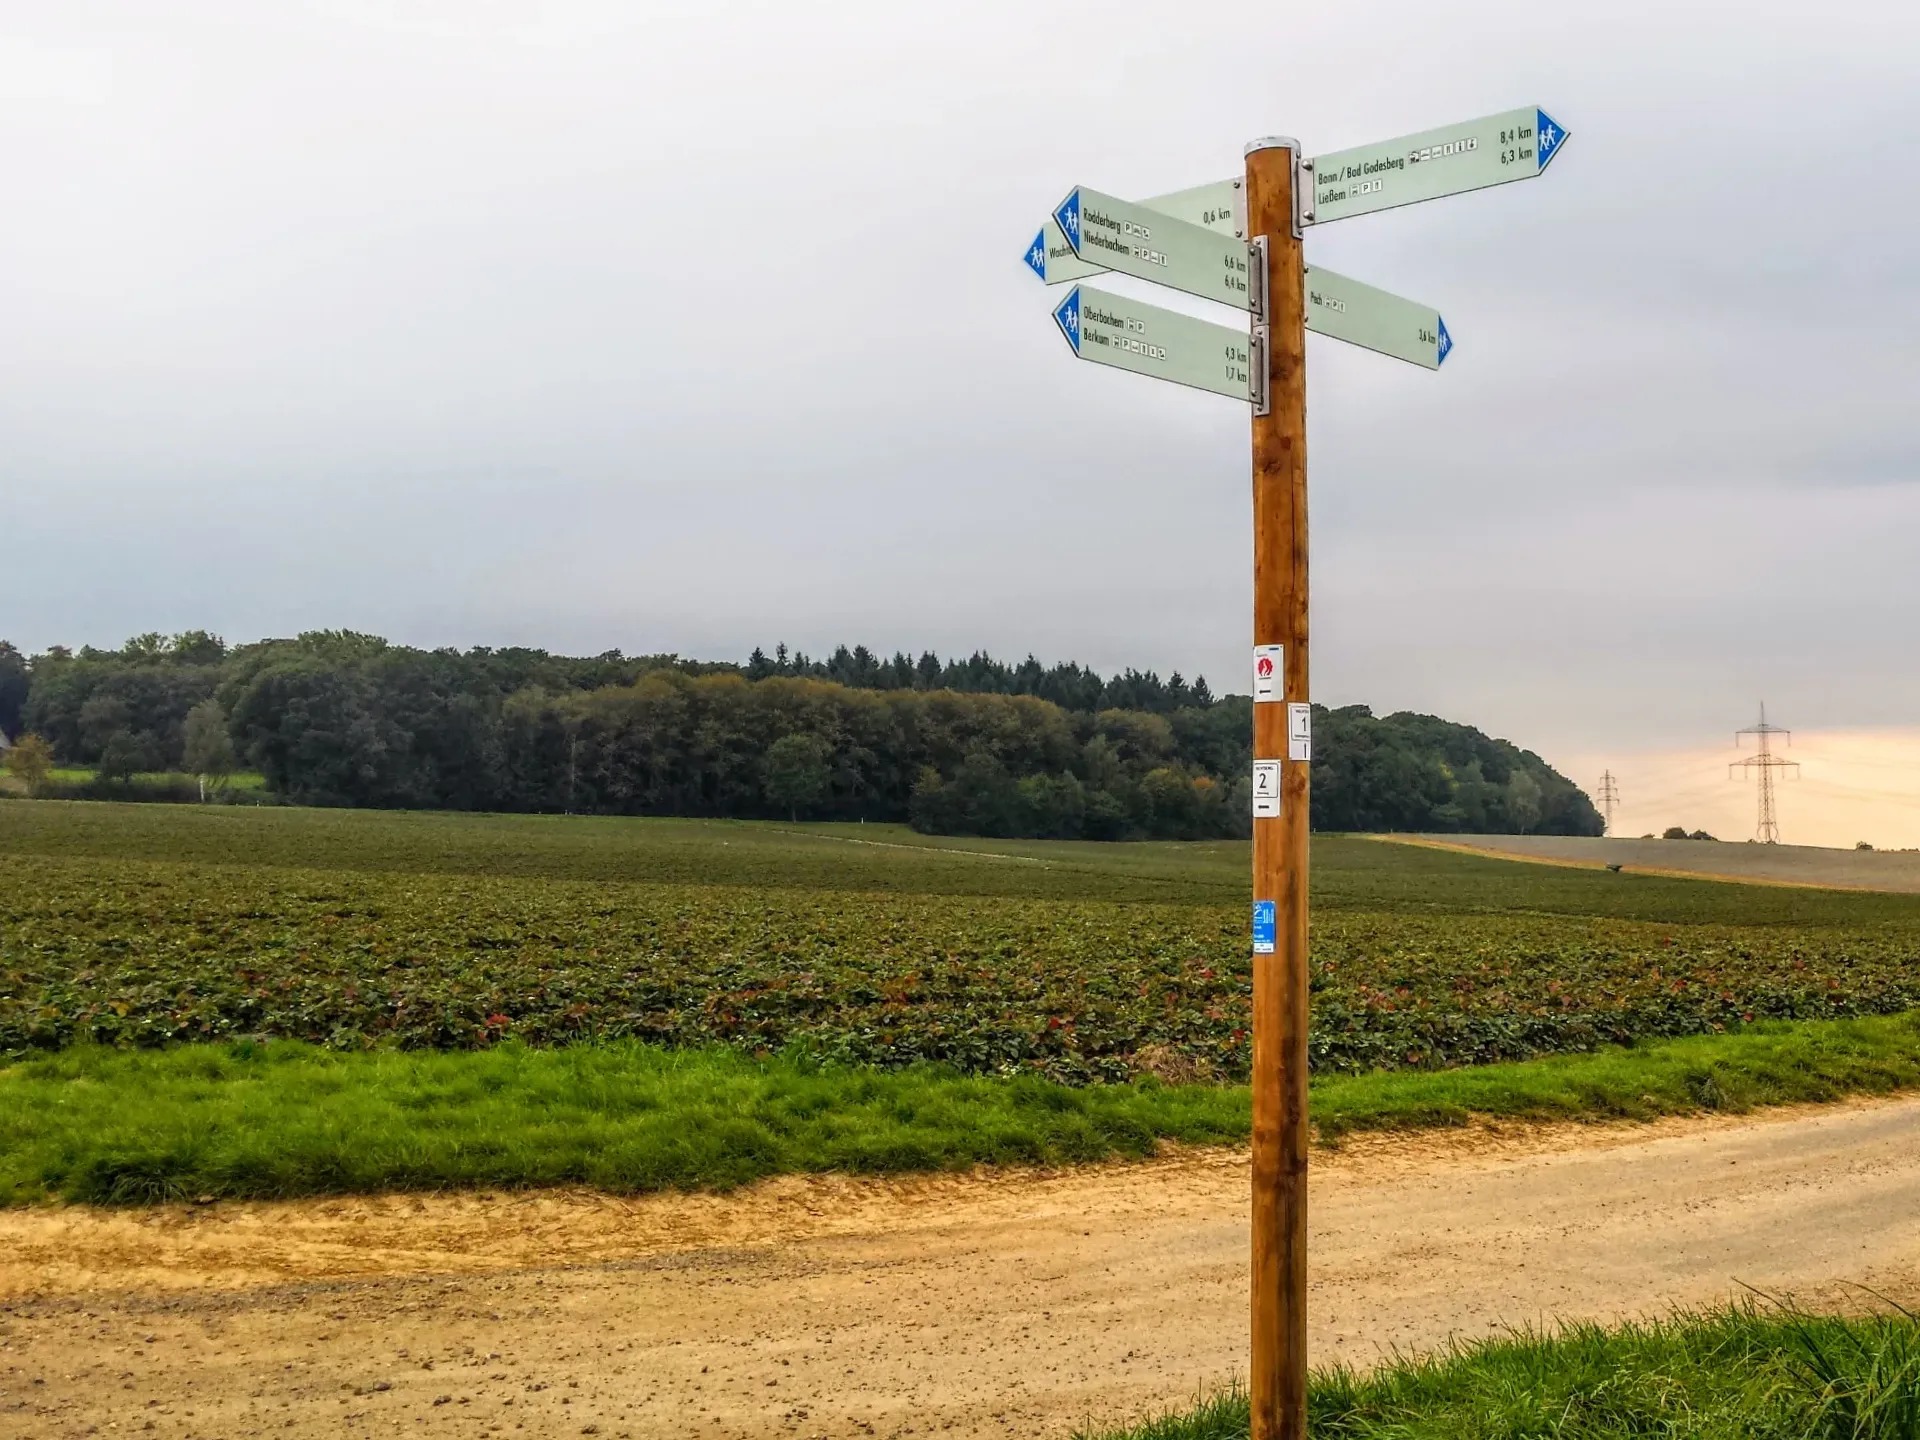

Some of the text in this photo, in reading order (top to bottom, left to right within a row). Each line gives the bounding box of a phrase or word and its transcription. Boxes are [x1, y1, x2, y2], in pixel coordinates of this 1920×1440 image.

[1500, 126, 1532, 145] 8,4 km
[1501, 146, 1532, 166] 6,3 km
[1318, 157, 1404, 185] Bonn / Bad Godesberg
[1318, 189, 1346, 205] Ließem
[1083, 207, 1121, 234] Rodderberg
[1203, 207, 1231, 225] 0,6 km
[1083, 229, 1130, 255] Niederbachem
[1224, 255, 1246, 273] 6,6 km
[1224, 275, 1246, 292] 6,4 km
[1083, 306, 1124, 329] Oberbachem
[1083, 327, 1110, 346] Berkum
[1419, 328, 1436, 344] 3,6 km
[1225, 346, 1247, 363] 4,3 km
[1225, 365, 1247, 383] 1,7 km
[1302, 716, 1307, 732] 1
[1259, 773, 1267, 789] 2
